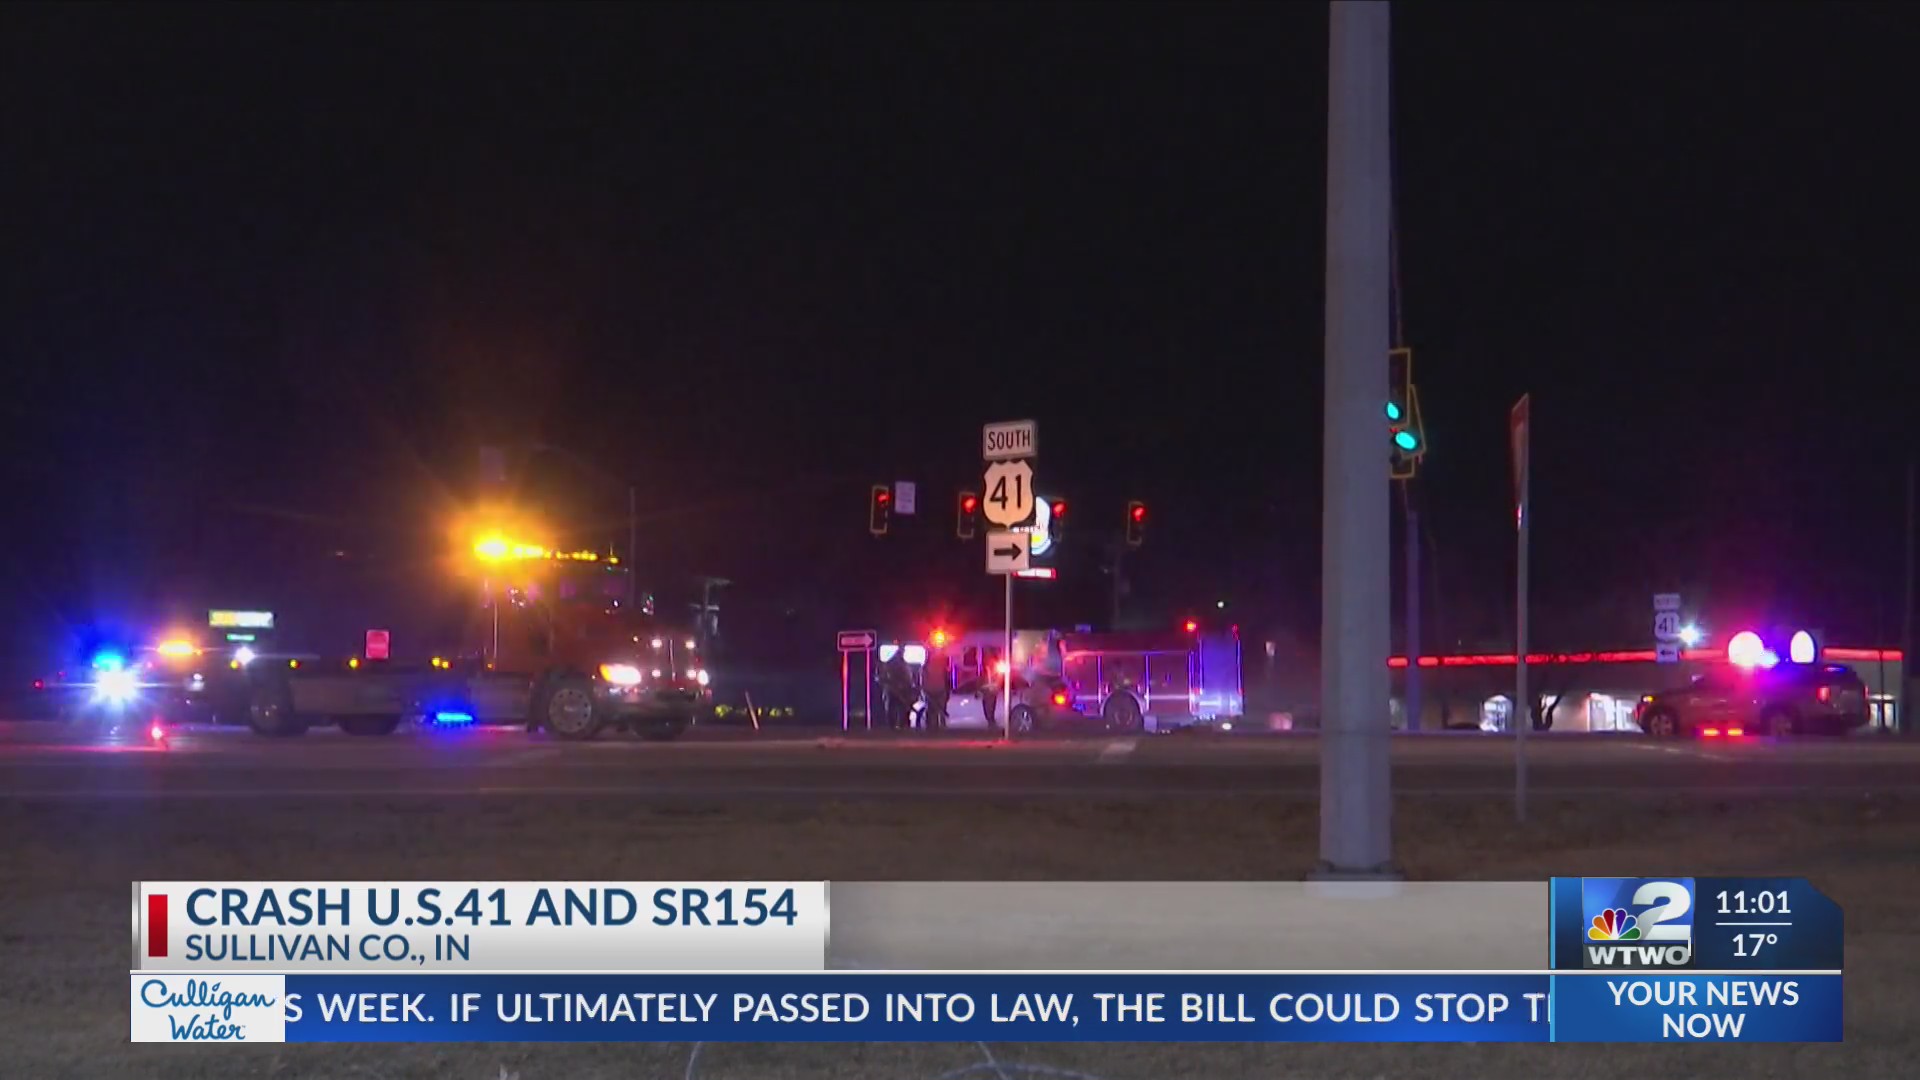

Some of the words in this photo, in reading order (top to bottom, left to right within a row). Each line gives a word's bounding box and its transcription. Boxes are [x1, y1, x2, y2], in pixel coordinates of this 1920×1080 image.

[987, 429, 1032, 452] SOUTH
[989, 473, 1023, 510] 41
[1658, 617, 1675, 633] 41
